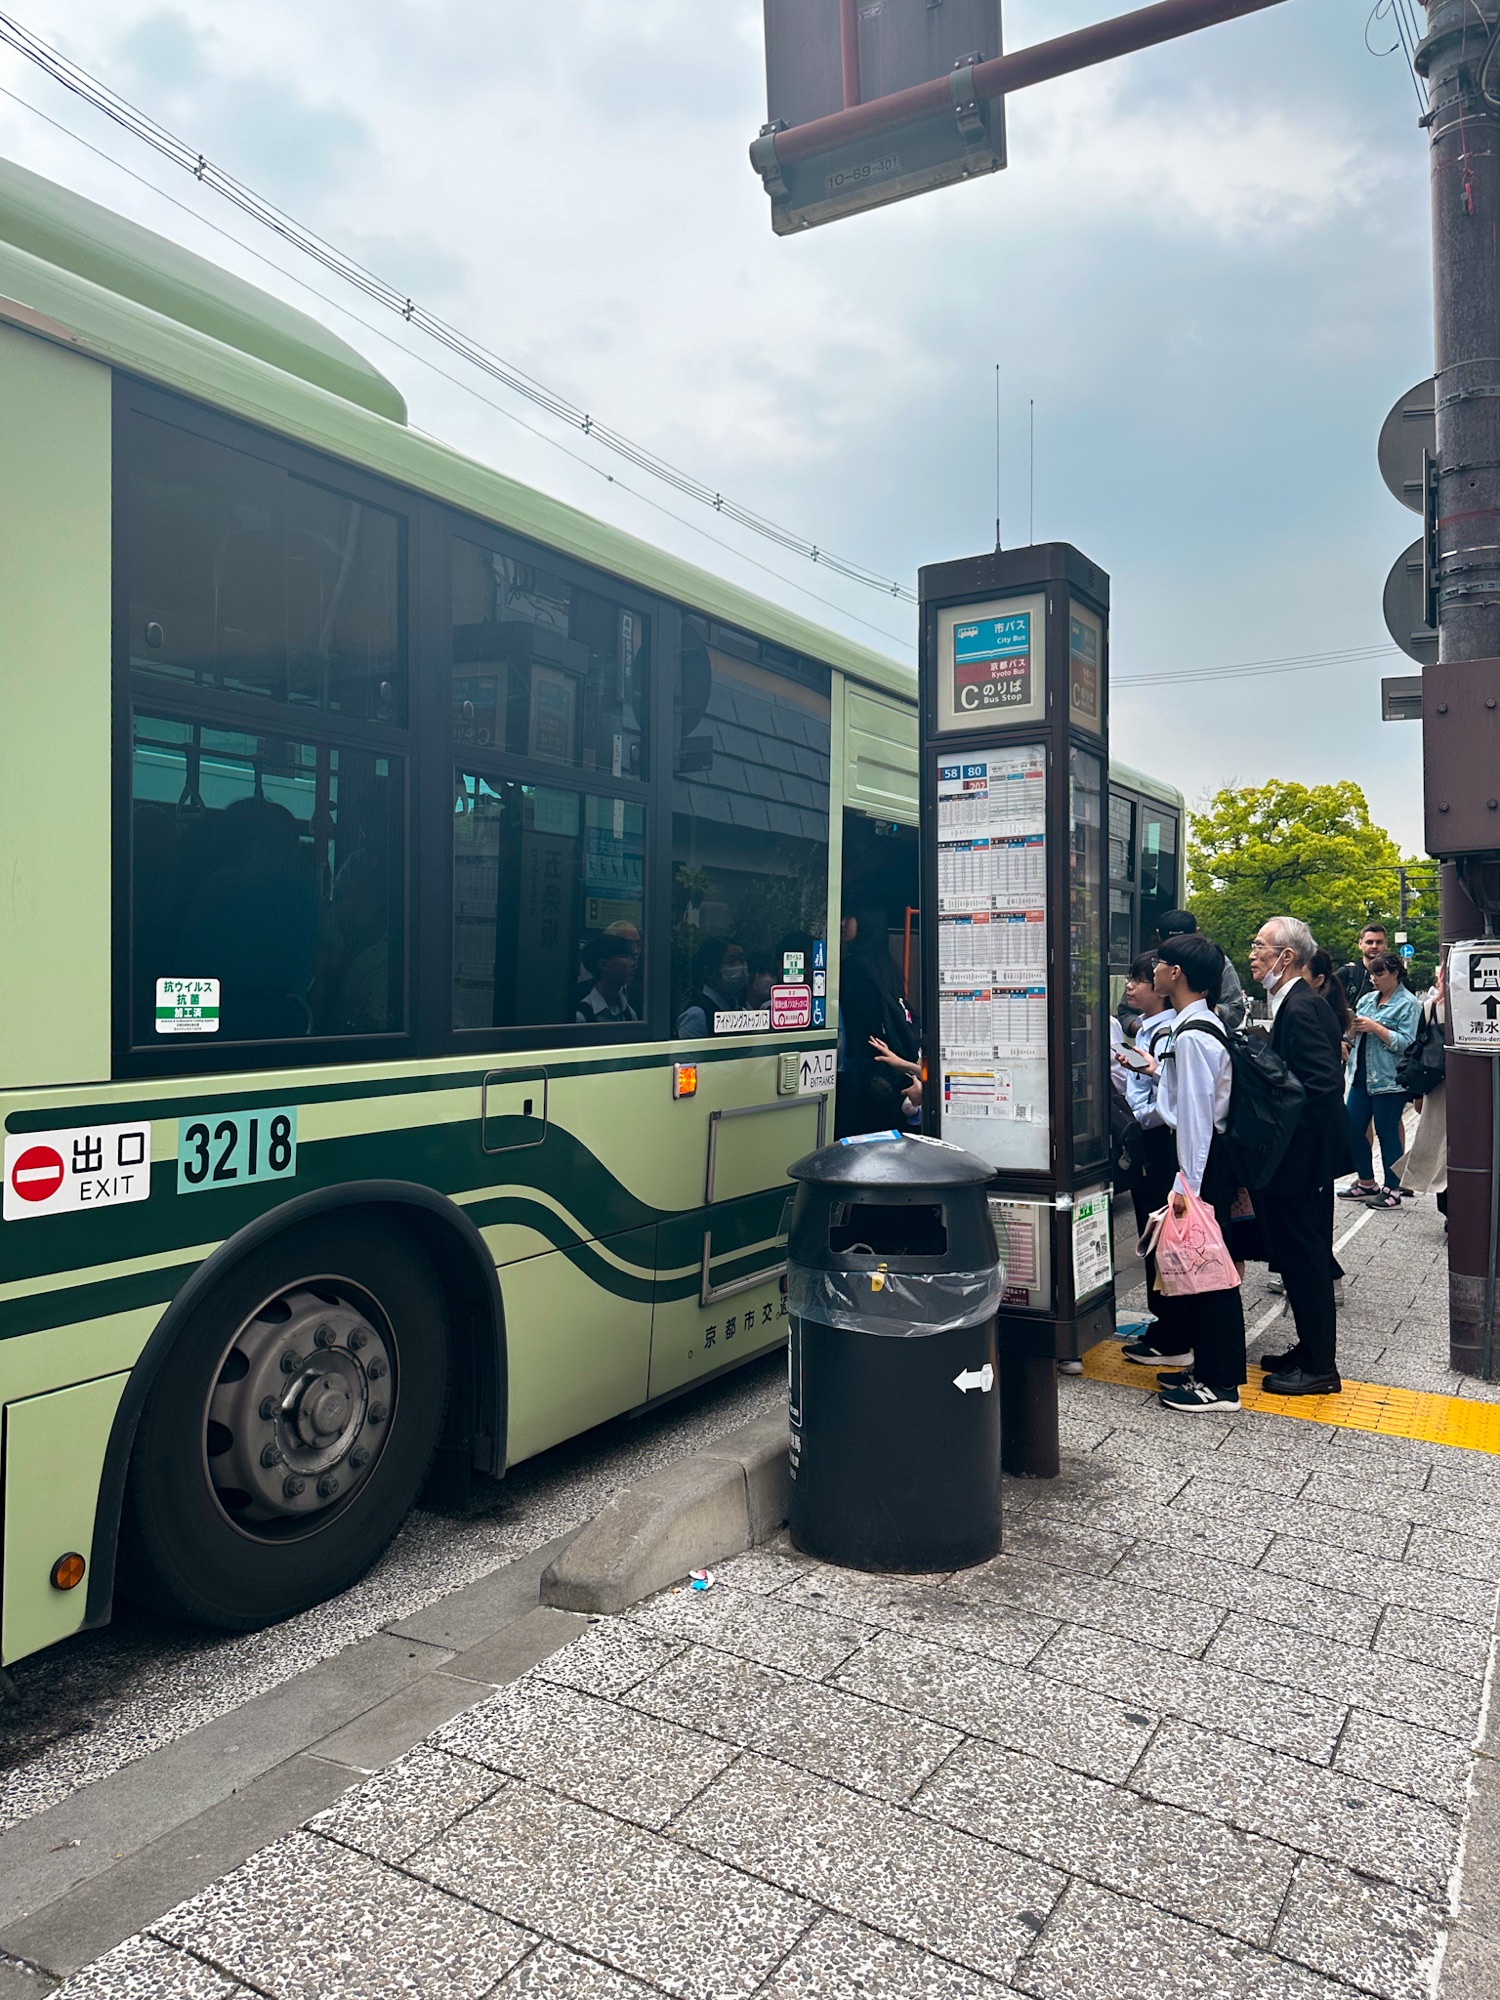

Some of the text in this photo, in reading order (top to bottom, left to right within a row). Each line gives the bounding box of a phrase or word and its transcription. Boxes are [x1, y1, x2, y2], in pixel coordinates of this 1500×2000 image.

[994, 620, 1026, 634] 市バス
[990, 659, 1026, 671] 京都バス
[991, 670, 1011, 679] Kyoto
[961, 679, 1022, 709] C のりば
[984, 693, 1022, 704] Bus Stop
[944, 768, 958, 779] 58
[967, 766, 982, 777] 80
[969, 782, 986, 791] 202
[164, 981, 212, 993] 抗ウイルス
[177, 994, 199, 1005] 抗菌
[174, 1007, 202, 1018] 加工済
[716, 1012, 769, 1029] アイドリングストップバス
[1470, 1021, 1499, 1033] 清水
[813, 1054, 833, 1074] 入口
[810, 1075, 834, 1088] ENTRANCE
[72, 1132, 145, 1174] 出口
[184, 1114, 292, 1184] 3218
[80, 1175, 135, 1201] EXIT
